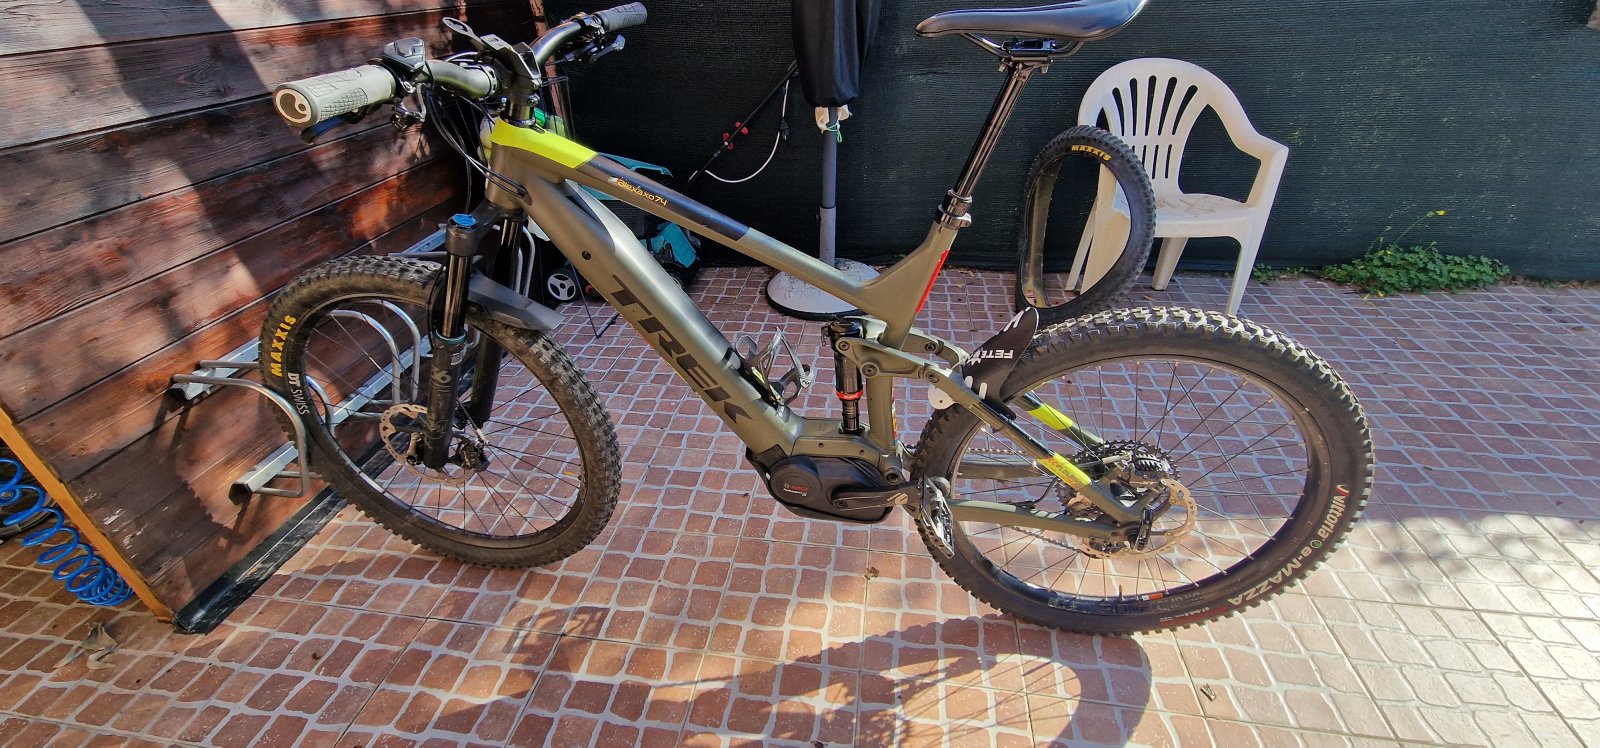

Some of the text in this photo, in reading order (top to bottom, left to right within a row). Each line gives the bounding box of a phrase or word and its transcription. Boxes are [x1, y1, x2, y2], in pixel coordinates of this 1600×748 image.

[1071, 145, 1112, 161] MAXXIS
[270, 315, 297, 377] MAXXIS
[610, 274, 753, 424] TREK
[287, 372, 310, 415] DT SWISS
